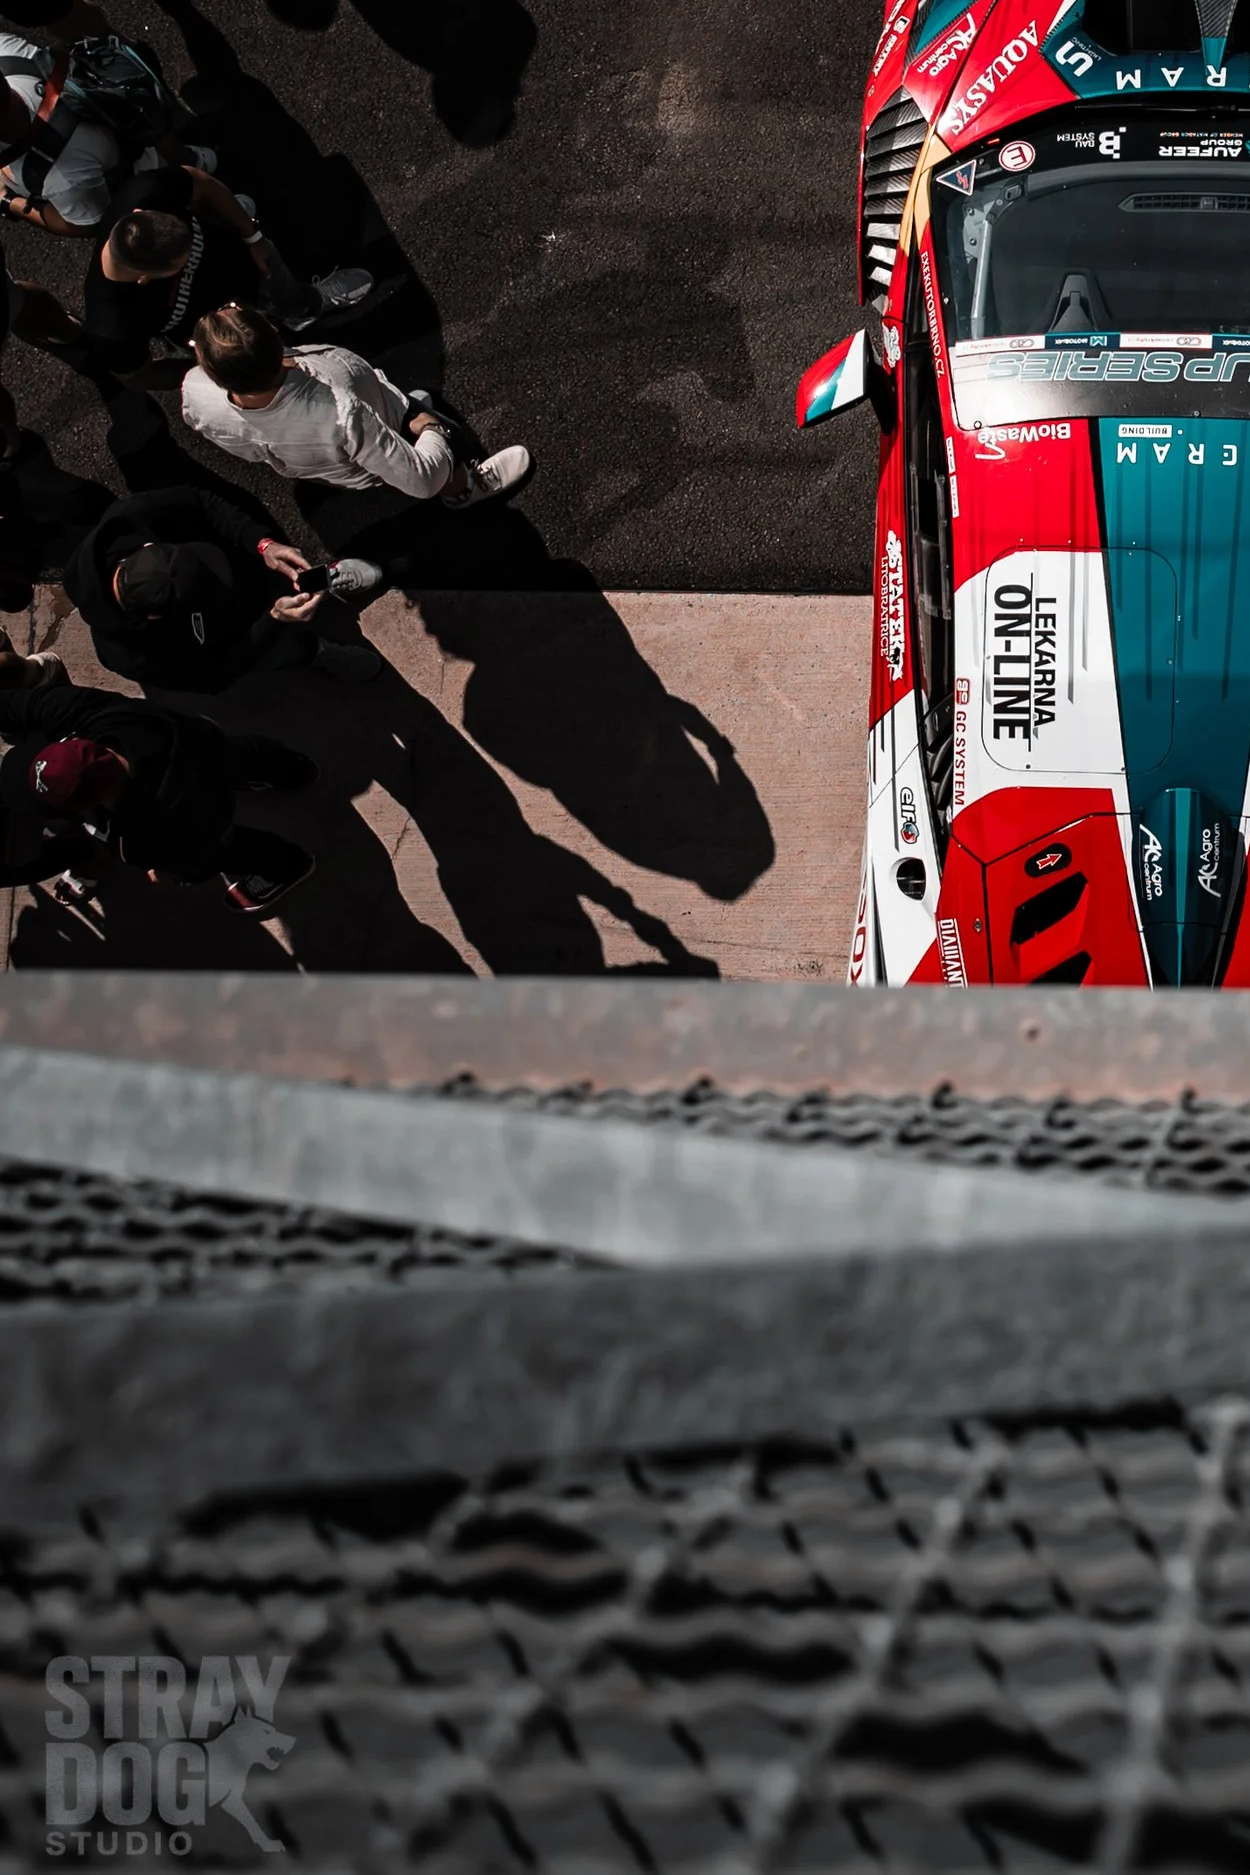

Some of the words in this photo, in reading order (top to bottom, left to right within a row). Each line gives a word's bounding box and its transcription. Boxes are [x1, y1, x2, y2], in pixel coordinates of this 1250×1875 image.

[917, 42, 949, 73] centrum
[929, 51, 959, 76] Agro
[951, 20, 1039, 136] AQUASYS
[1056, 132, 1095, 142] SYSTEM
[1075, 139, 1095, 148] BAU
[1158, 145, 1243, 158] AUFEER
[919, 250, 945, 379] EXEKUTORBRNO.CZ
[977, 422, 1070, 445] BioWaste
[1121, 427, 1168, 435] BUILDING
[880, 556, 889, 656] LITOBRATRICE
[888, 555, 905, 656] STATEK
[993, 584, 1032, 740] ON-LINE
[955, 711, 967, 733] GC
[954, 737, 966, 806] SYSTEM
[900, 786, 916, 825] elf
[1200, 828, 1213, 862] Agro
[1213, 822, 1221, 861] centrum
[1144, 863, 1153, 901] centrum
[1151, 863, 1163, 896] Agro
